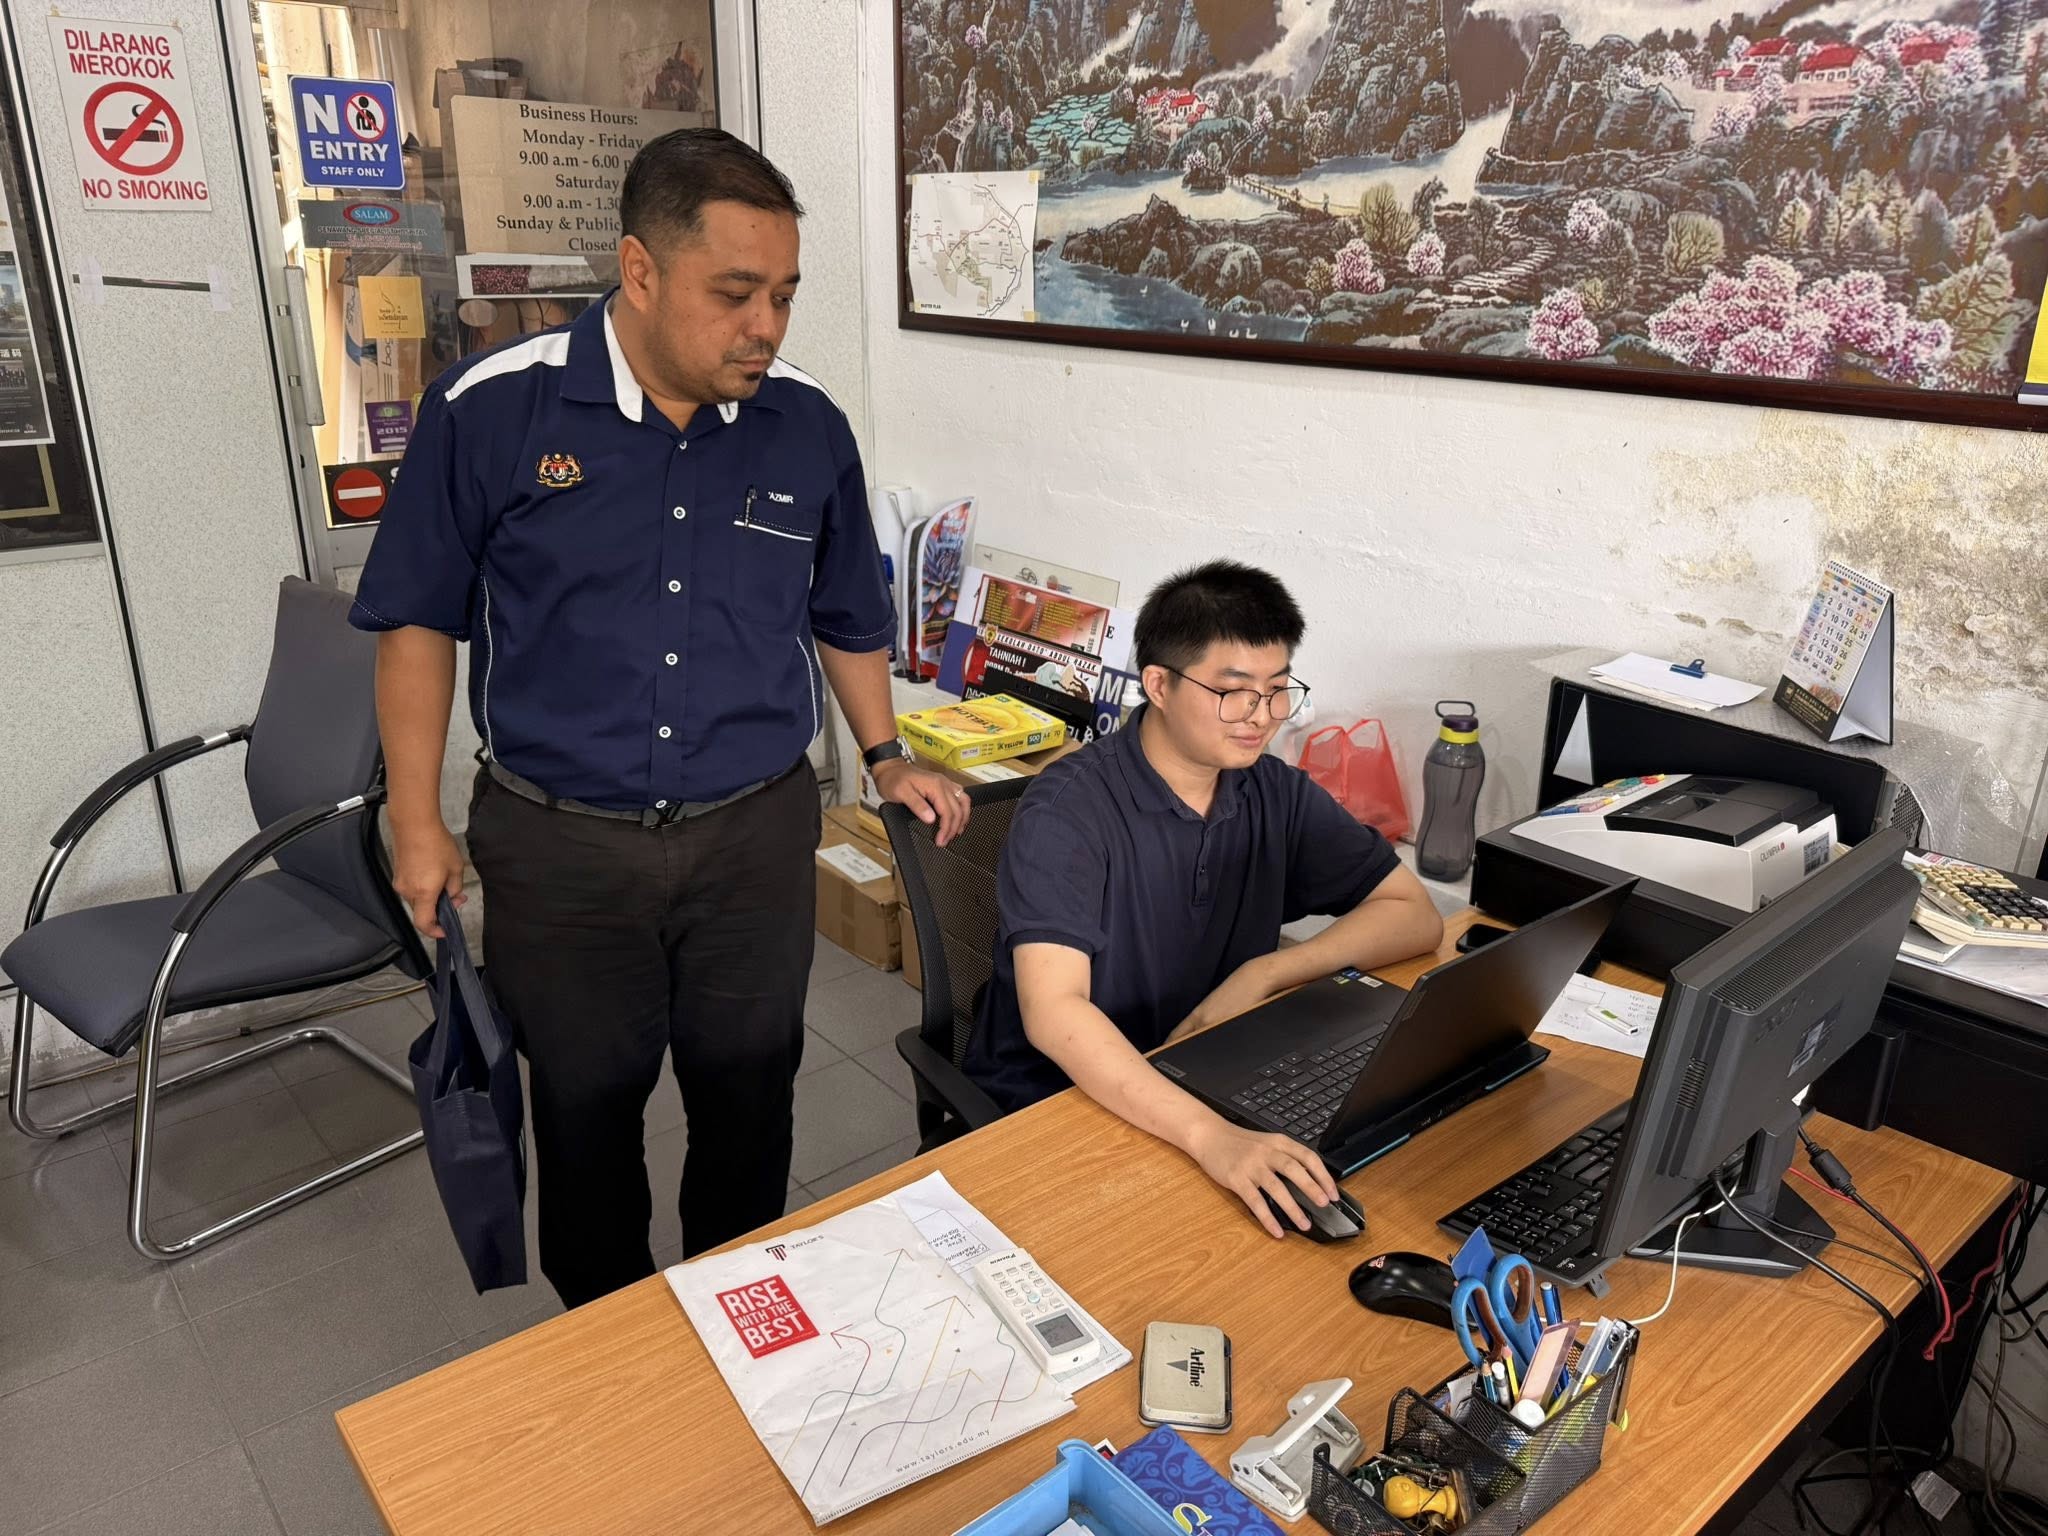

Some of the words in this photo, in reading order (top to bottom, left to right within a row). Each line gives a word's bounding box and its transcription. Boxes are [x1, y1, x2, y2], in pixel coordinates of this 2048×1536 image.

[64, 29, 171, 57] DILARANG
[69, 52, 175, 79] MEROKOK
[519, 103, 586, 122] Business
[590, 109, 639, 126] Hours:
[523, 128, 585, 150] Monday
[599, 133, 643, 149] Friday
[309, 140, 389, 163] ENTRY
[519, 151, 549, 165] 9.00
[552, 155, 579, 167] a.m
[592, 154, 620, 169] 6.00
[321, 165, 354, 177] STAFF
[357, 166, 385, 178] ONLY
[82, 178, 113, 200] NO
[117, 178, 209, 202] SMOKING
[555, 174, 620, 194] Saturday
[523, 194, 553, 208] 9.00
[556, 199, 582, 210] a.m
[354, 209, 390, 220] SALAM
[496, 215, 554, 234] Sunday
[559, 216, 572, 231] &
[576, 217, 621, 232] Public
[568, 238, 618, 251] Closed
[376, 426, 409, 435] 2015
[1823, 609, 1828, 617] 3
[1831, 615, 1839, 624] 10
[1840, 620, 1849, 629] 17
[1849, 625, 1858, 635] 24
[1859, 631, 1867, 640] 31
[1837, 603, 1842, 611] 9
[1846, 608, 1854, 617] 16
[1855, 613, 1863, 622] 23
[1864, 619, 1873, 629] 30
[1826, 627, 1834, 636] 11
[1835, 632, 1843, 642] 18
[1844, 637, 1853, 648] 25
[989, 646, 1022, 667] TAHNIAH
[1816, 650, 1824, 659] 13
[1825, 656, 1833, 665] 20
[1834, 661, 1842, 670] 27
[1821, 639, 1829, 648] 12
[1830, 644, 1838, 654] 19
[1839, 650, 1848, 660] 26
[1028, 734, 1040, 744] 500
[722, 1279, 788, 1317] RISE
[735, 1309, 770, 1329] WITH
[768, 1300, 796, 1316] THE
[742, 1311, 807, 1349] BEST
[1190, 1347, 1205, 1387] Artline
[896, 1429, 990, 1473] www.taylors.edu.my
